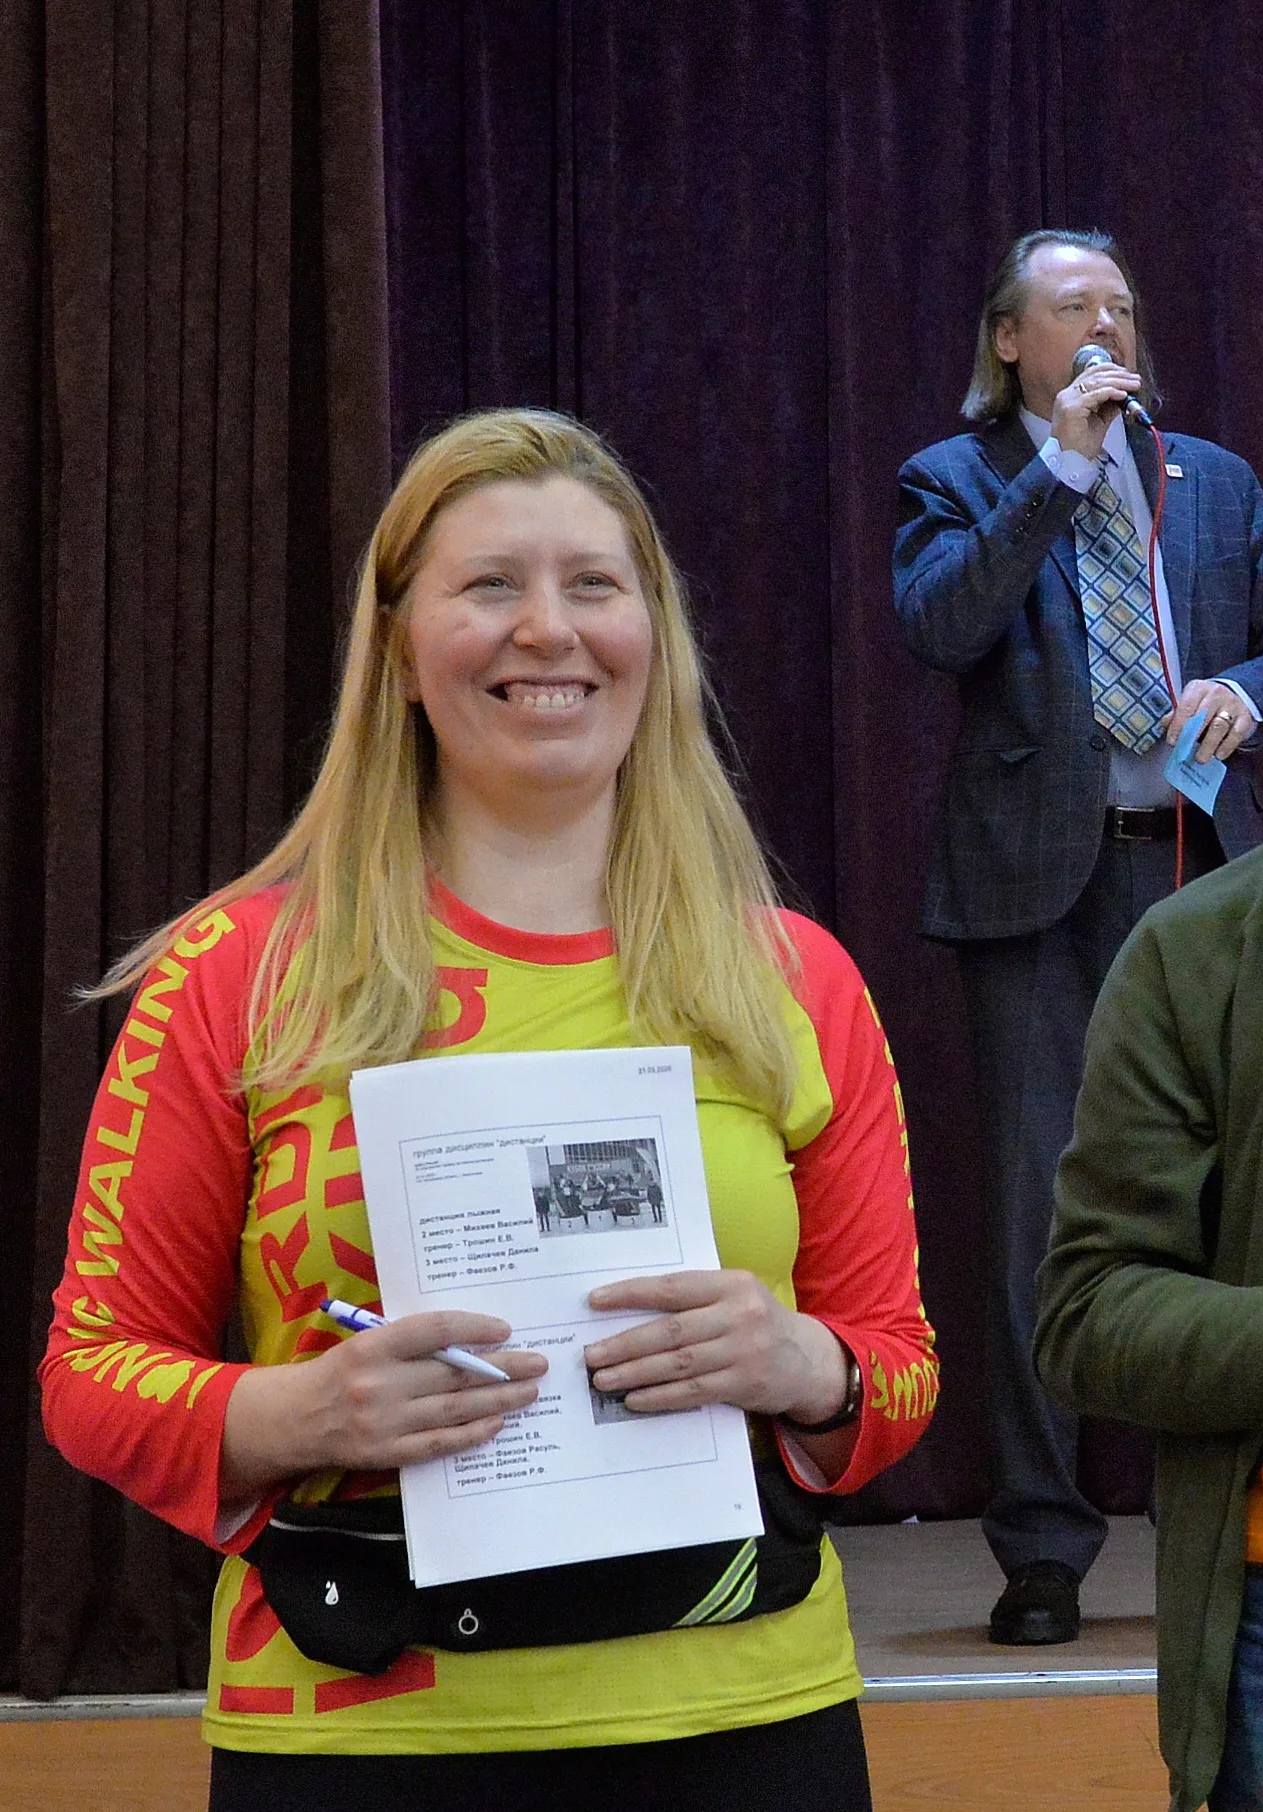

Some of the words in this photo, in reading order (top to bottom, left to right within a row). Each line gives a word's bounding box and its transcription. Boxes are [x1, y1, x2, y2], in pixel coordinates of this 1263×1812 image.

[76, 908, 236, 1277] WALKING
[429, 1228, 454, 1237] место
[497, 1217, 534, 1228] Василий
[424, 1243, 453, 1253] тренер
[433, 1256, 458, 1266] место
[427, 1271, 457, 1281] тренер
[461, 1454, 487, 1463] место
[457, 1476, 487, 1487] тренер
